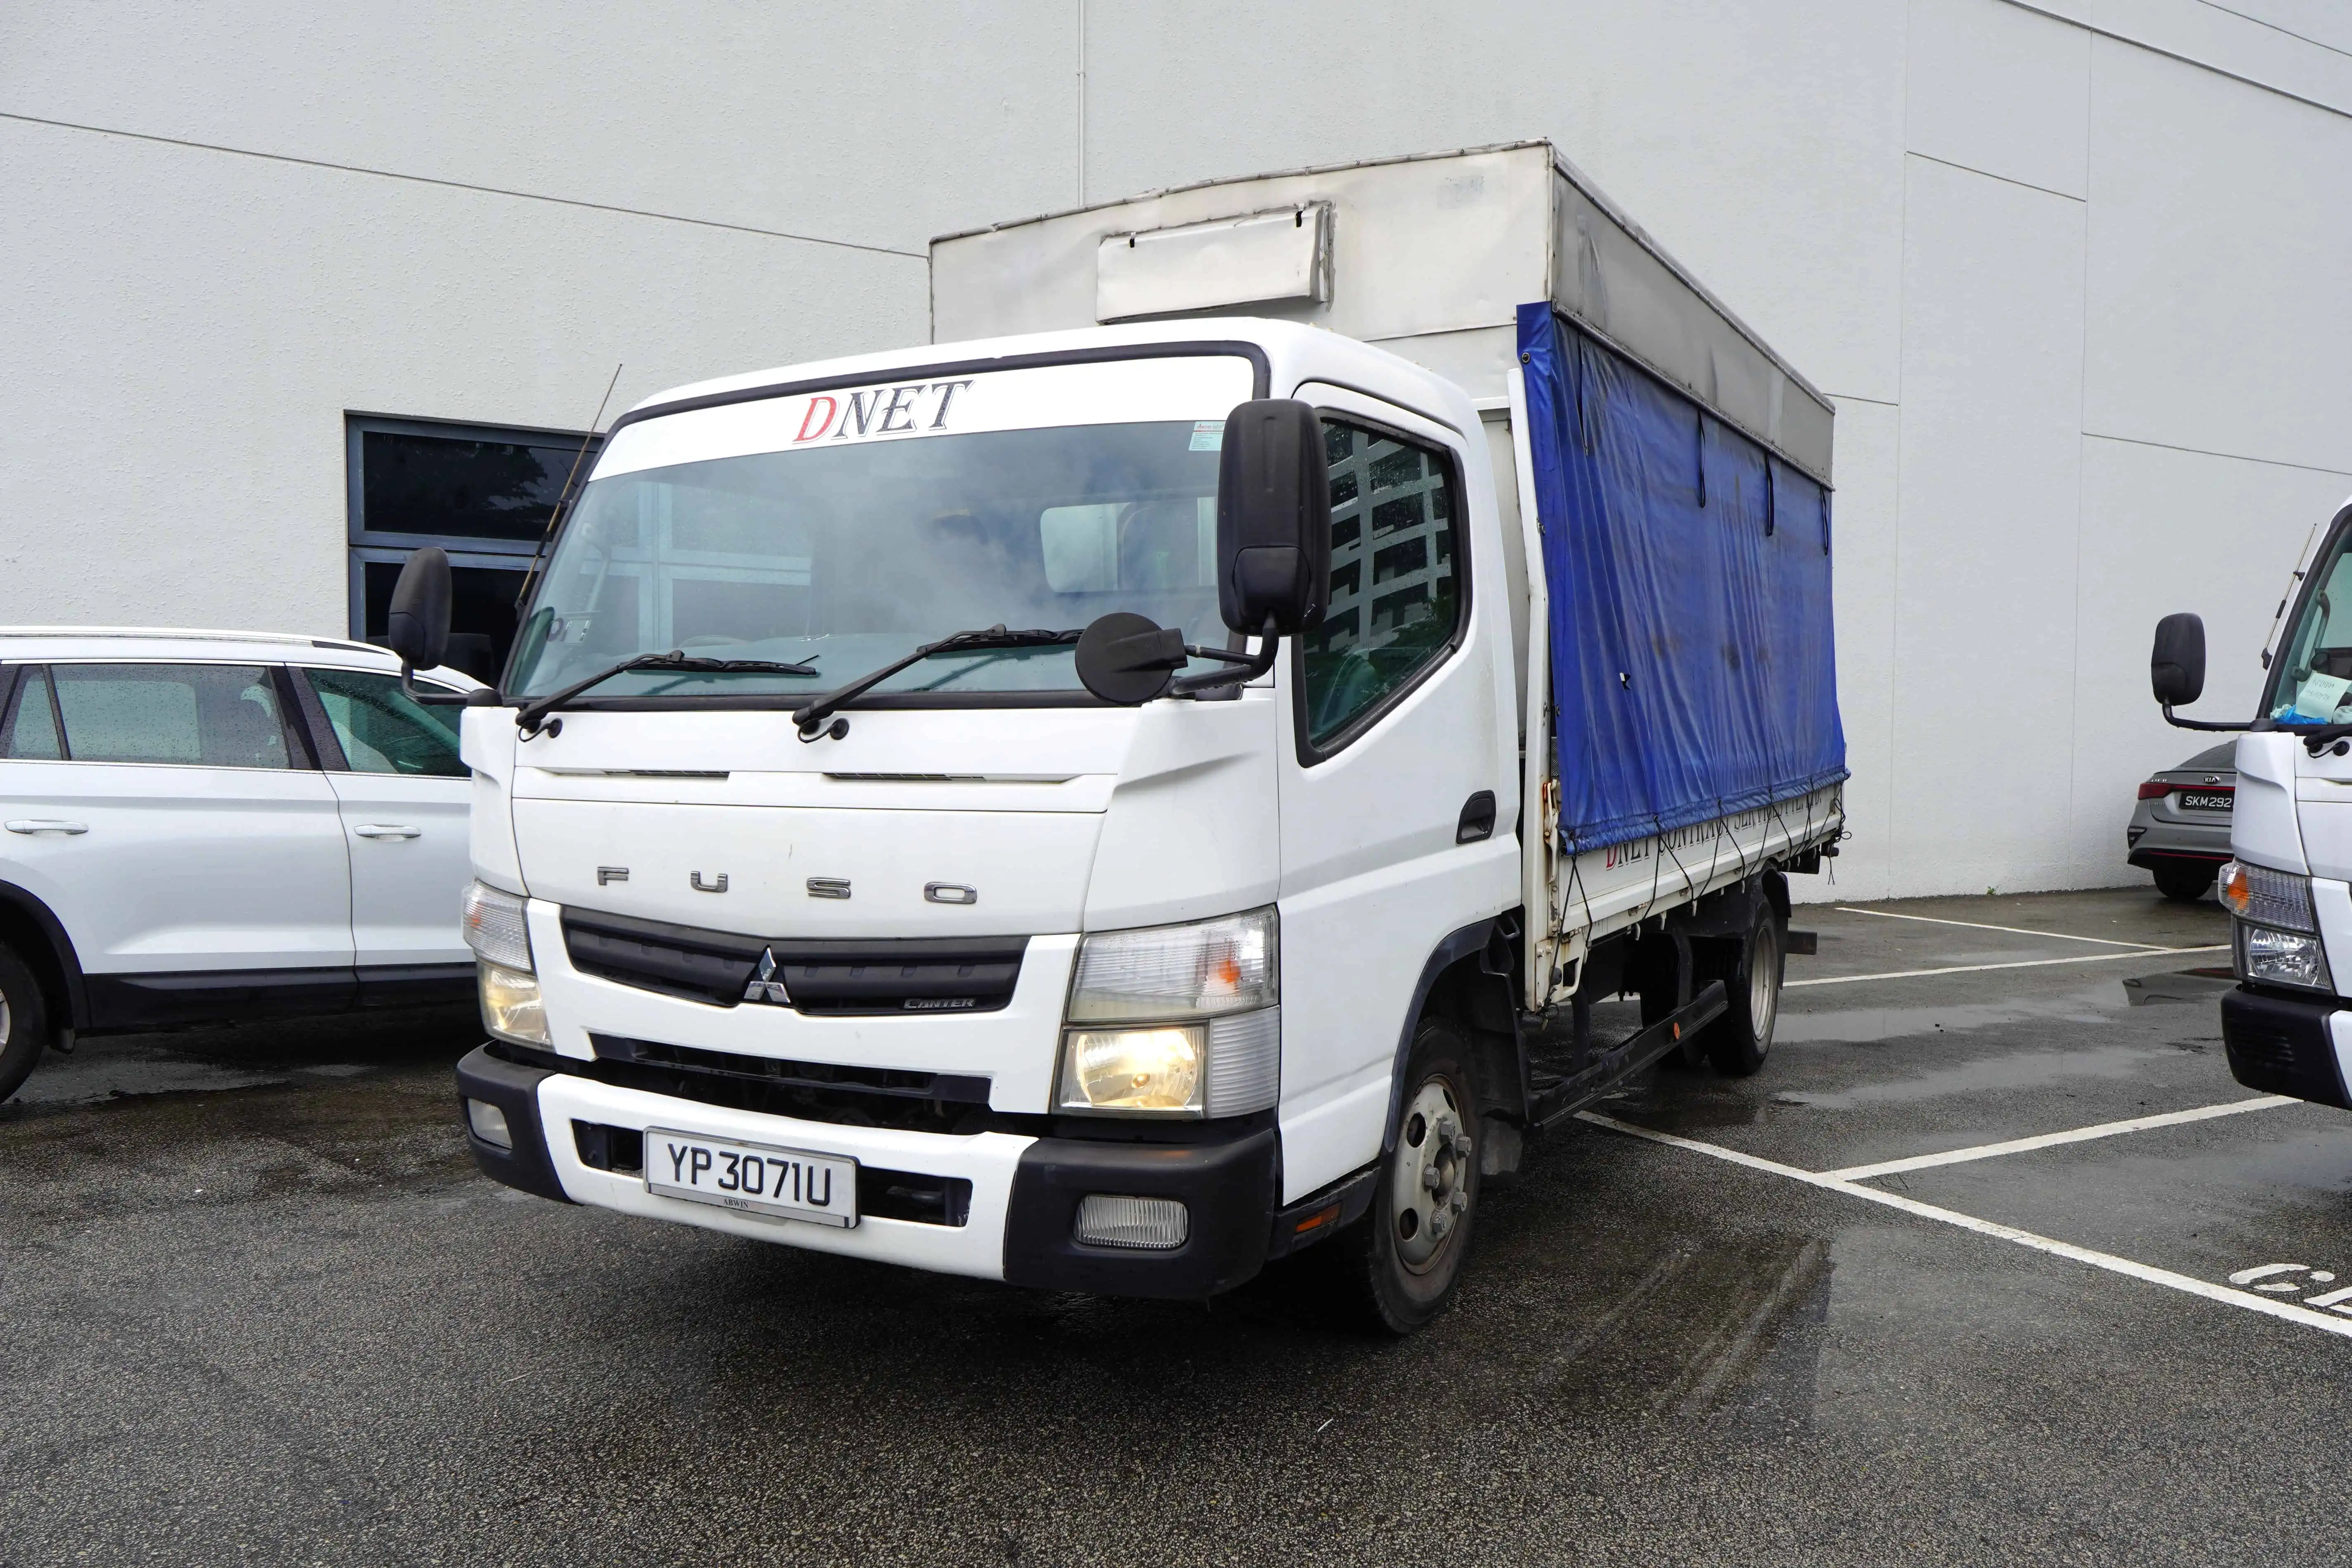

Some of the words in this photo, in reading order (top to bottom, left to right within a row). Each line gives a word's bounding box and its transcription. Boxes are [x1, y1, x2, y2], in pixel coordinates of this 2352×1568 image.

[792, 380, 976, 445] DNET
[597, 866, 978, 904] FUSO
[904, 998, 976, 1009] CANTER
[667, 1143, 831, 1206] YP3071U
[723, 1198, 749, 1208] ABWIN
